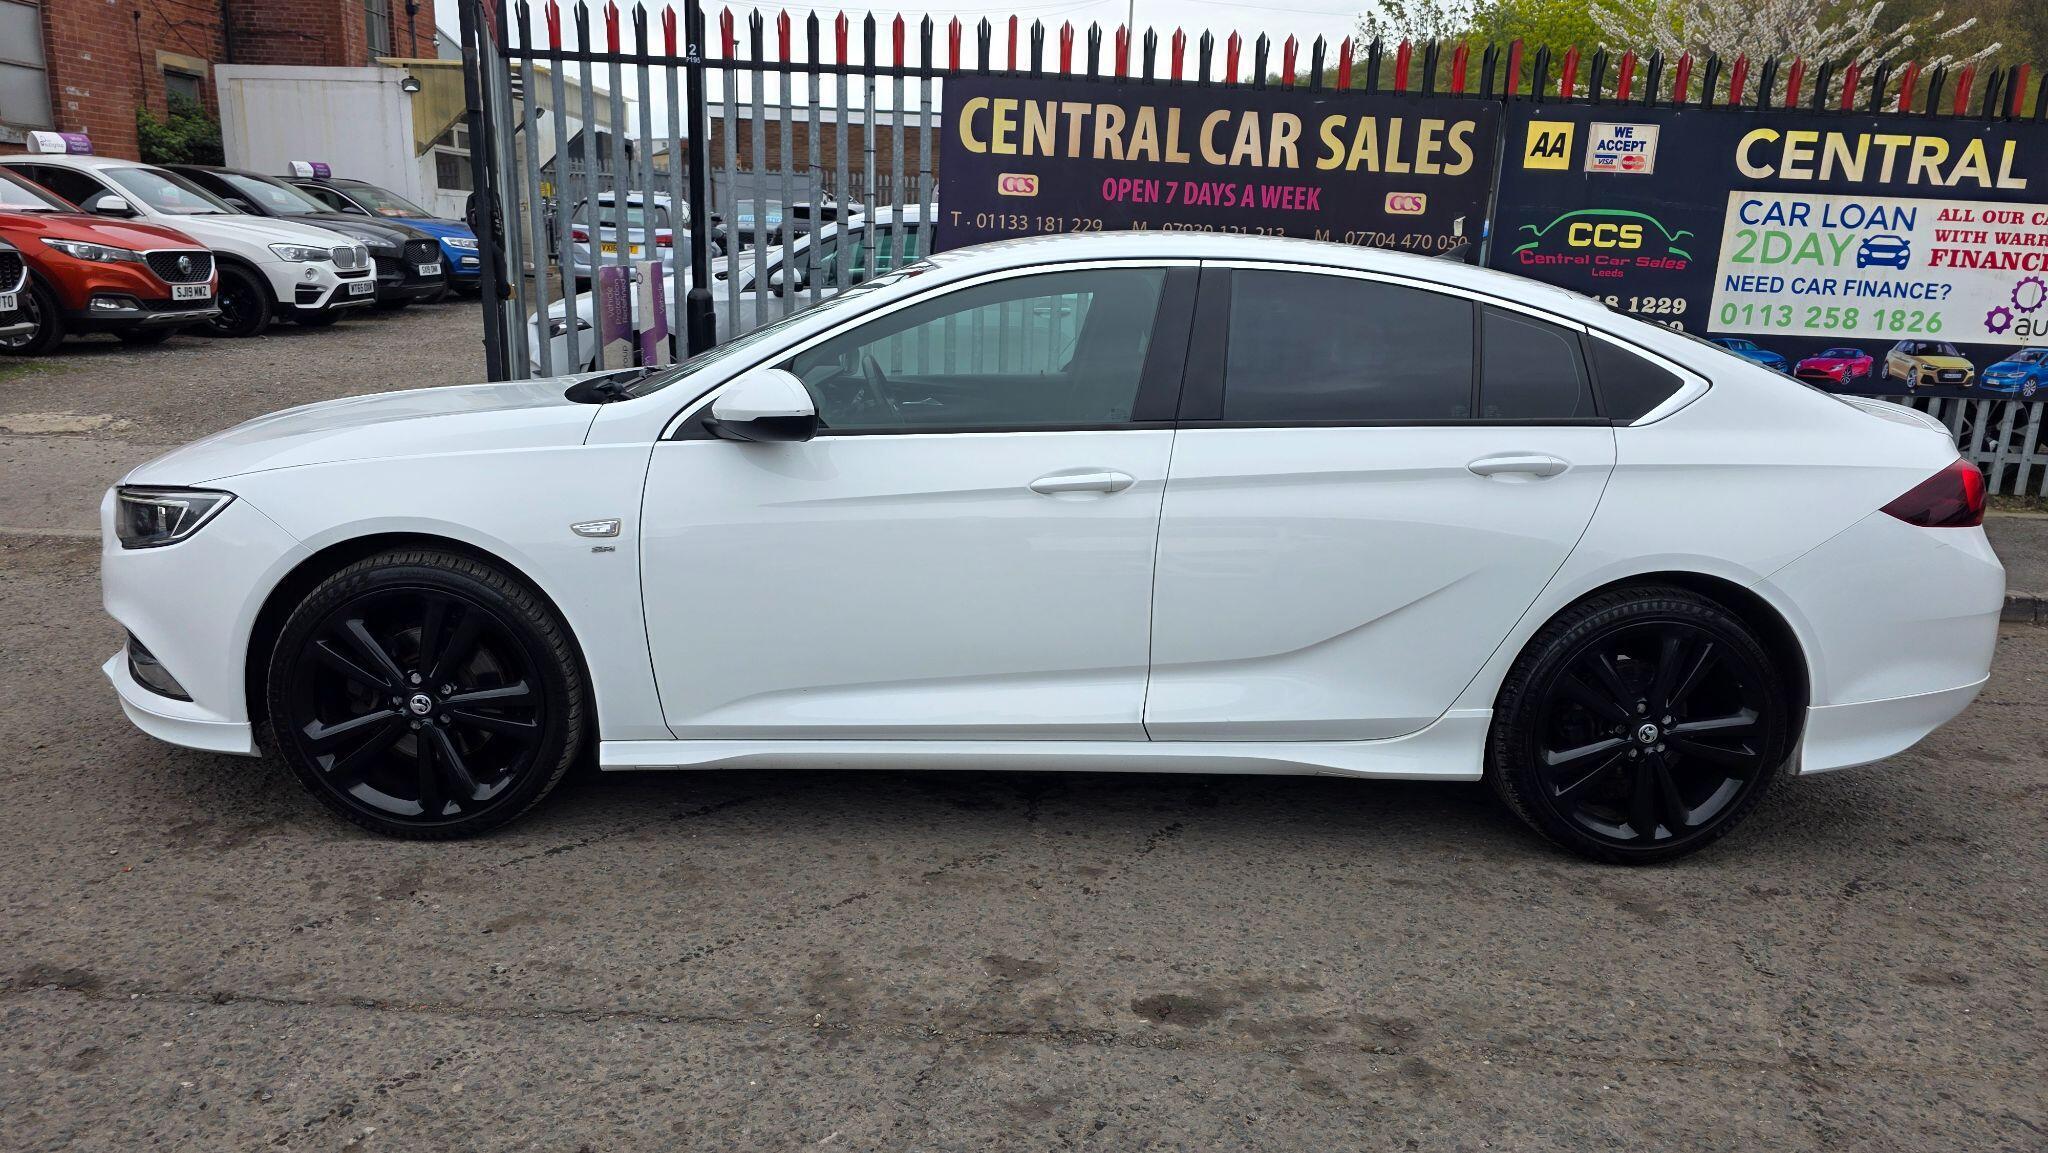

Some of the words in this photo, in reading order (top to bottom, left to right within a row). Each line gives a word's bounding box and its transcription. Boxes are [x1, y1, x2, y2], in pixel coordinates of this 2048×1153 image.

[689, 43, 697, 56] 2
[959, 96, 1191, 164] CENTRAL
[1199, 109, 1303, 169] CAR
[1315, 114, 1477, 177] SALES
[1529, 131, 1567, 158] AA
[1614, 126, 1634, 139] WE
[1596, 139, 1647, 153] ACCEPT
[1735, 127, 2028, 190] CENTRAL
[1102, 177, 1160, 204] OPEN
[1165, 181, 1179, 204] 7
[1183, 181, 1236, 207] DAYS
[1240, 184, 1255, 208] A
[1260, 184, 1322, 211] WEEK
[976, 212, 1029, 231] 01133
[1035, 216, 1064, 233] 181
[1071, 217, 1103, 233] 229
[1739, 199, 1811, 228] CAR
[1821, 203, 1918, 232] LOAN
[1937, 208, 1975, 222] ALL
[1982, 210, 2025, 225] OUR
[2031, 212, 2048, 226] C
[1344, 230, 1396, 249] 07704
[1400, 233, 1433, 250] 470
[1568, 222, 1644, 249] CCS
[1731, 228, 1856, 267] 2DAY
[1934, 229, 1989, 244] WITH
[1519, 249, 1590, 266] Central
[1594, 255, 1631, 267] Car
[1635, 256, 1687, 270] Sales
[1591, 267, 1625, 278] Leeds
[1724, 274, 1785, 294] NEED
[1791, 276, 1838, 296] CAR
[1843, 278, 1953, 301] FINANCE?
[614, 278, 622, 326] Protection
[1627, 296, 1688, 315] 1229
[1720, 301, 1794, 328] 0113
[1804, 305, 1860, 330] 258
[1872, 308, 1943, 334] 1826
